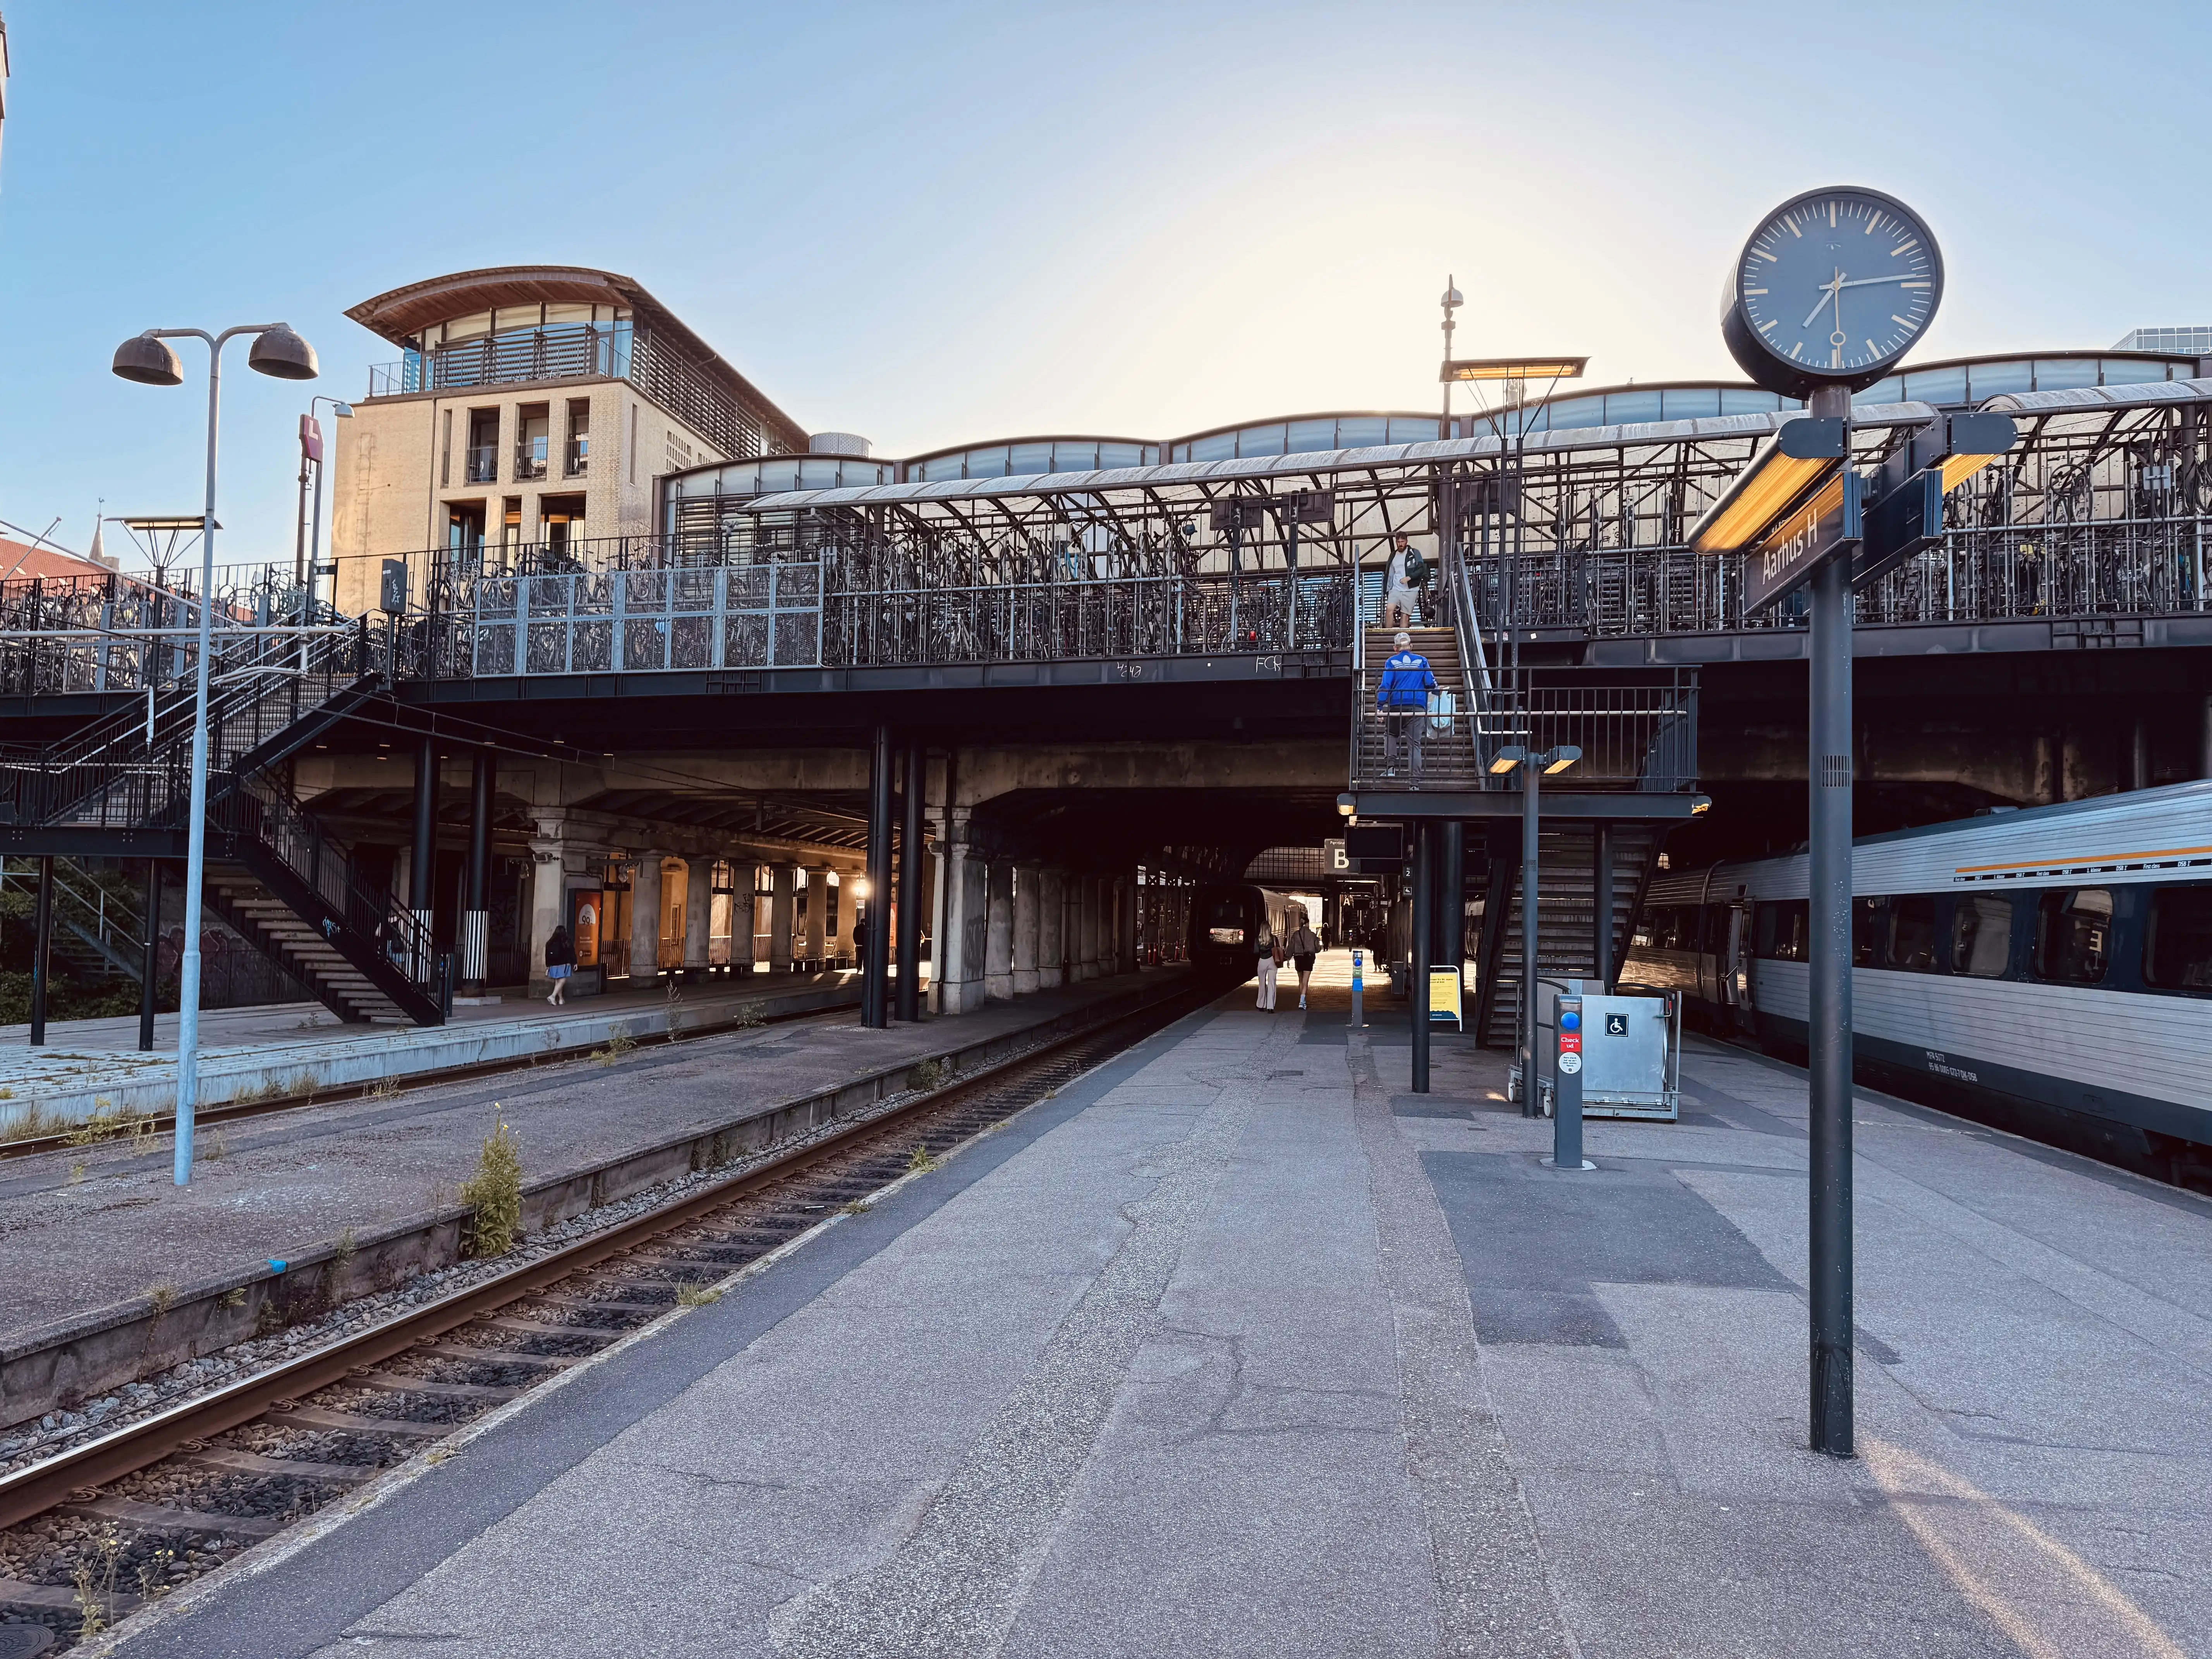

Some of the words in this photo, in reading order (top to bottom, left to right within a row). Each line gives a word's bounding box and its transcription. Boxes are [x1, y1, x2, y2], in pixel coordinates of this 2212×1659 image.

[1762, 529, 1803, 585] Aarhus
[1807, 508, 1817, 548] H
[1334, 848, 1349, 868] B
[1343, 898, 1350, 906] A
